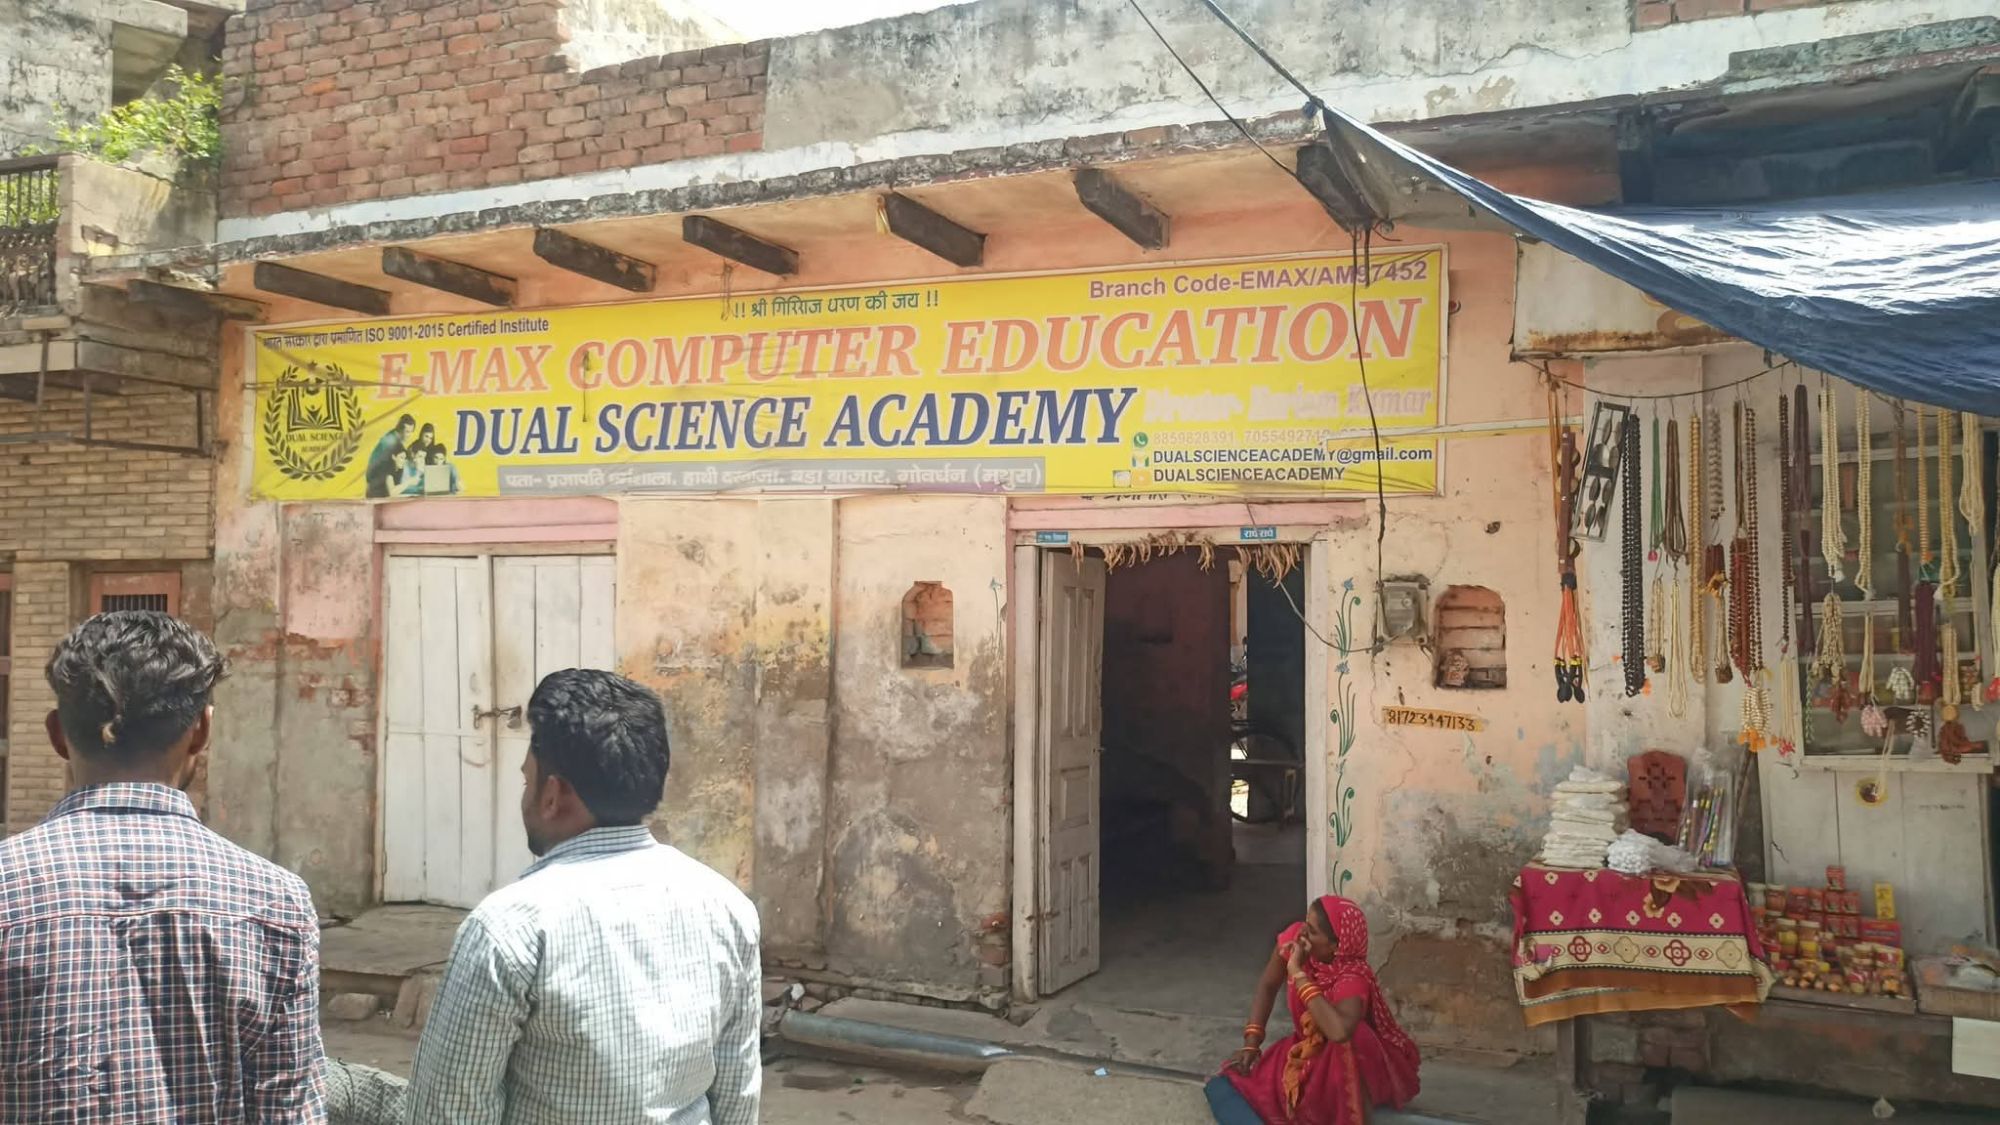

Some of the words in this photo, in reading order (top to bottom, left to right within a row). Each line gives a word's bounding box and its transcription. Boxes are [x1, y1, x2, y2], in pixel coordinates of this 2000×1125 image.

[1090, 277, 1166, 298] Branch
[865, 291, 888, 311] की
[892, 292, 920, 308] जय
[365, 327, 385, 342] ISO
[388, 323, 444, 340] 9001-2015
[447, 318, 496, 336] Certified
[500, 317, 549, 332] Institute
[376, 345, 552, 399] E-MAX
[568, 323, 921, 389] COMPUTER
[941, 298, 1424, 374] EDUCATION
[454, 406, 578, 456] DUAL
[595, 397, 809, 452] SCIENCE
[823, 388, 1138, 446] ACADEMY
[1153, 447, 1433, 465] DUALSCIENCEACADEMY@gmail.com
[1153, 466, 1345, 482] DUALSCIENCEACADEMY
